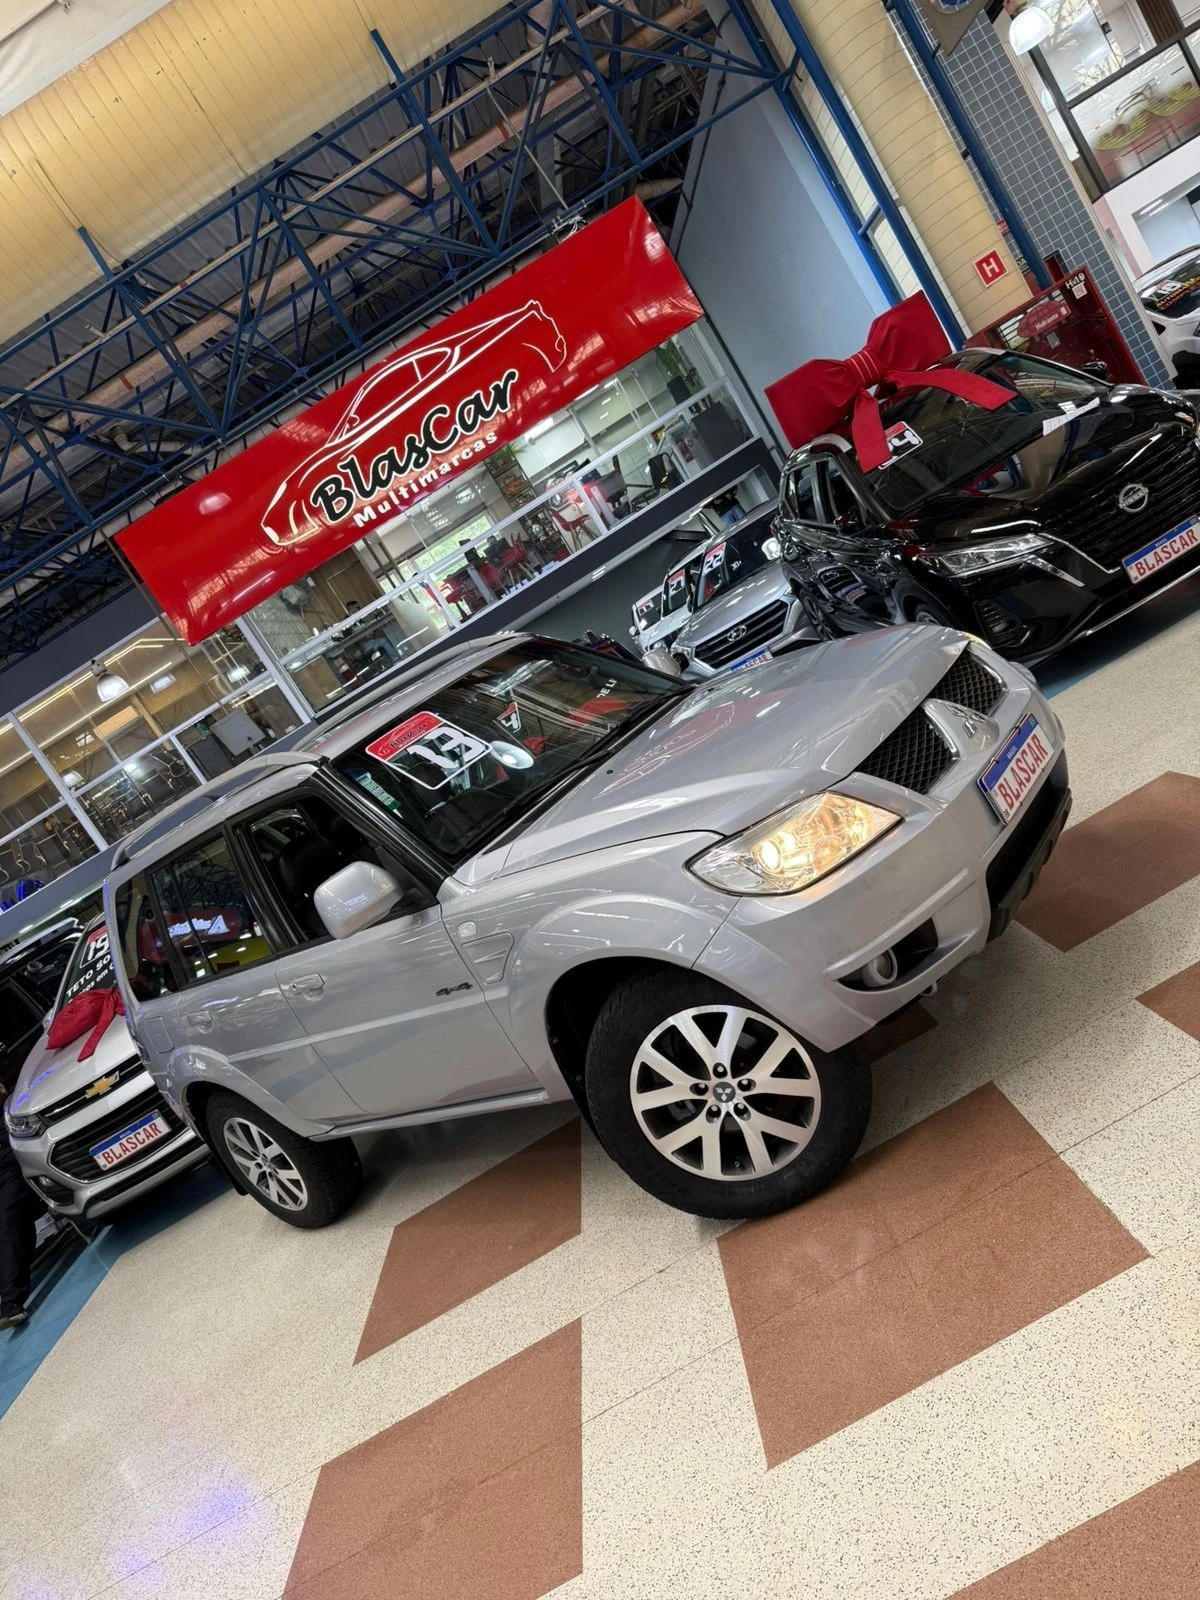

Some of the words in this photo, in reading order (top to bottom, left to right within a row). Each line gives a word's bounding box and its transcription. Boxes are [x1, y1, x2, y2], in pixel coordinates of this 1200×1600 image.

[981, 257, 1000, 278] H
[1035, 312, 1059, 331] Hidrante
[311, 370, 519, 525] BlasCar
[352, 431, 498, 528] Multimarcas
[1134, 528, 1199, 577] BLASCAR
[406, 726, 487, 769] 13
[997, 734, 1048, 811] BLASCAR
[87, 934, 110, 960] 19
[66, 970, 94, 997] TETO
[96, 954, 111, 971] SO
[101, 1122, 162, 1165] BLASCAR
